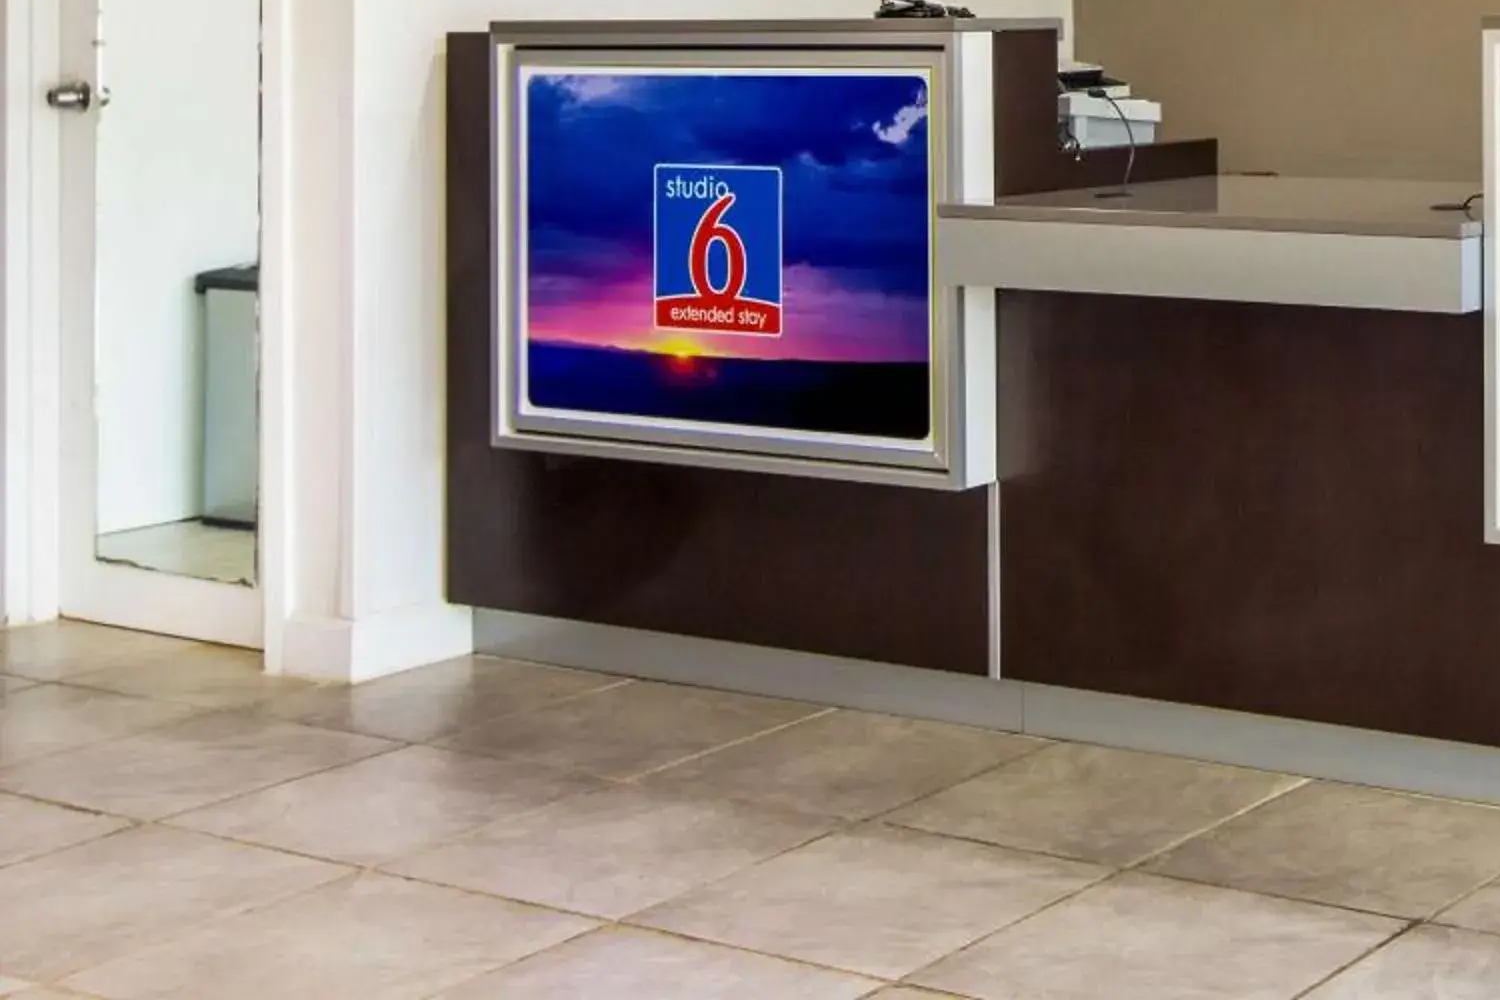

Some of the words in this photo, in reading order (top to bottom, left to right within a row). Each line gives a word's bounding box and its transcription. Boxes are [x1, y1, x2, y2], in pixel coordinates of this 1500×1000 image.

[665, 174, 730, 200] studio
[689, 192, 747, 299] 6
[670, 305, 735, 324] extended
[737, 308, 767, 329] stay
